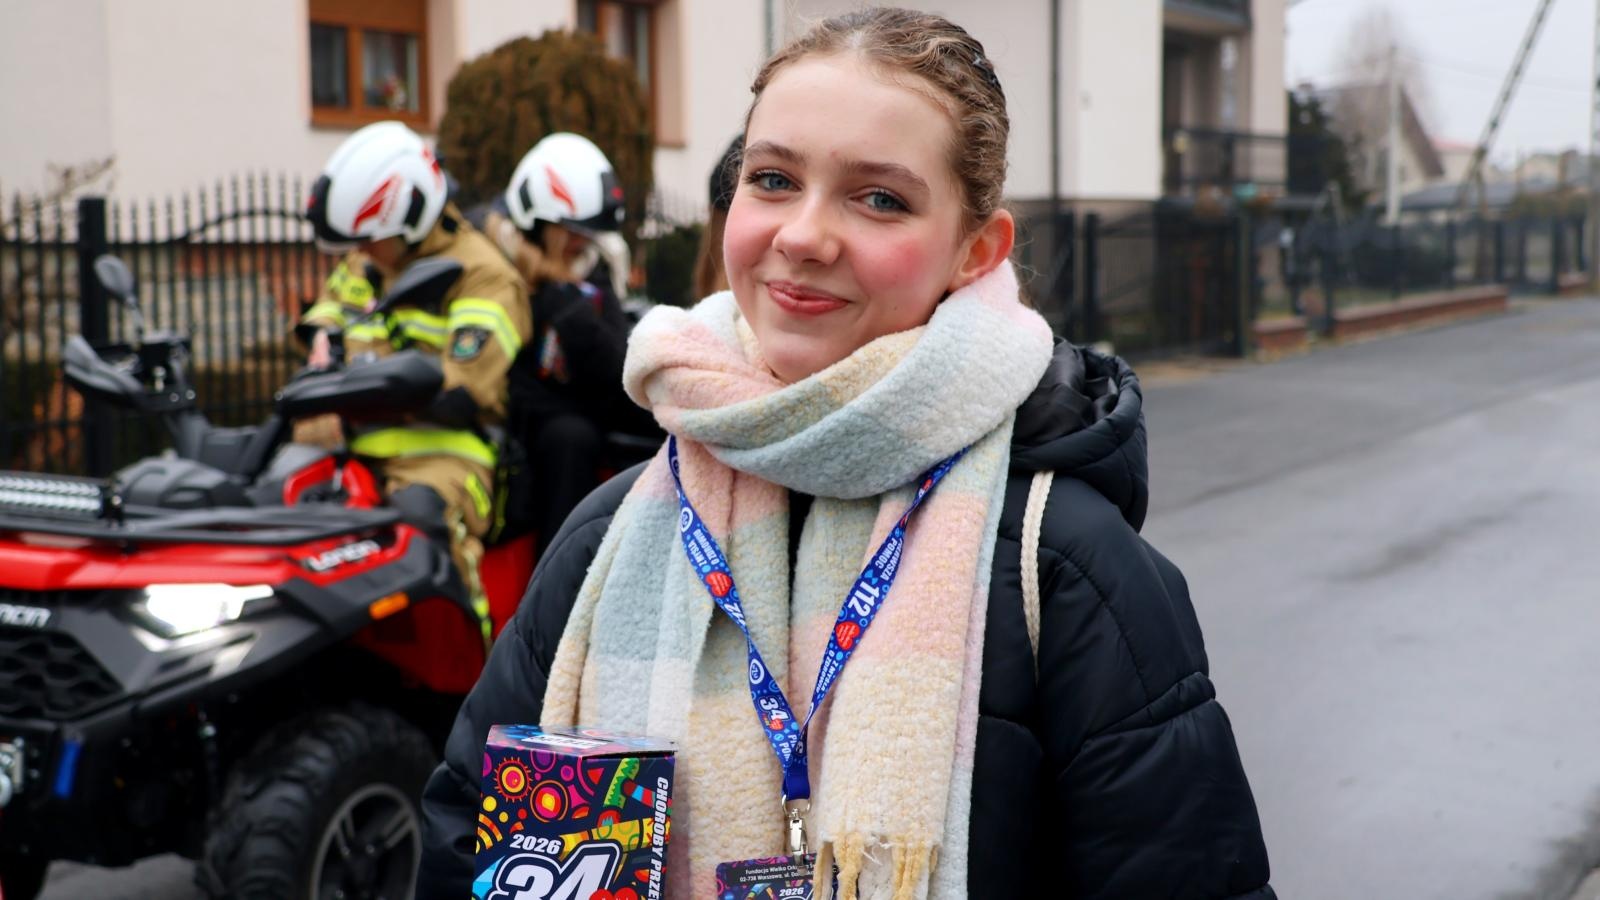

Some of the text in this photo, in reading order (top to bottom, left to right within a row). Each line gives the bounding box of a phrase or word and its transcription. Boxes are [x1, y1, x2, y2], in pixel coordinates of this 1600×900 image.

[693, 528, 717, 561] ZDROWIU
[875, 537, 898, 569] POMOC
[848, 581, 880, 617] 112
[760, 697, 790, 721] 34
[651, 776, 669, 858] CHOROBY
[510, 833, 562, 856] 2026
[779, 887, 805, 897] 2026
